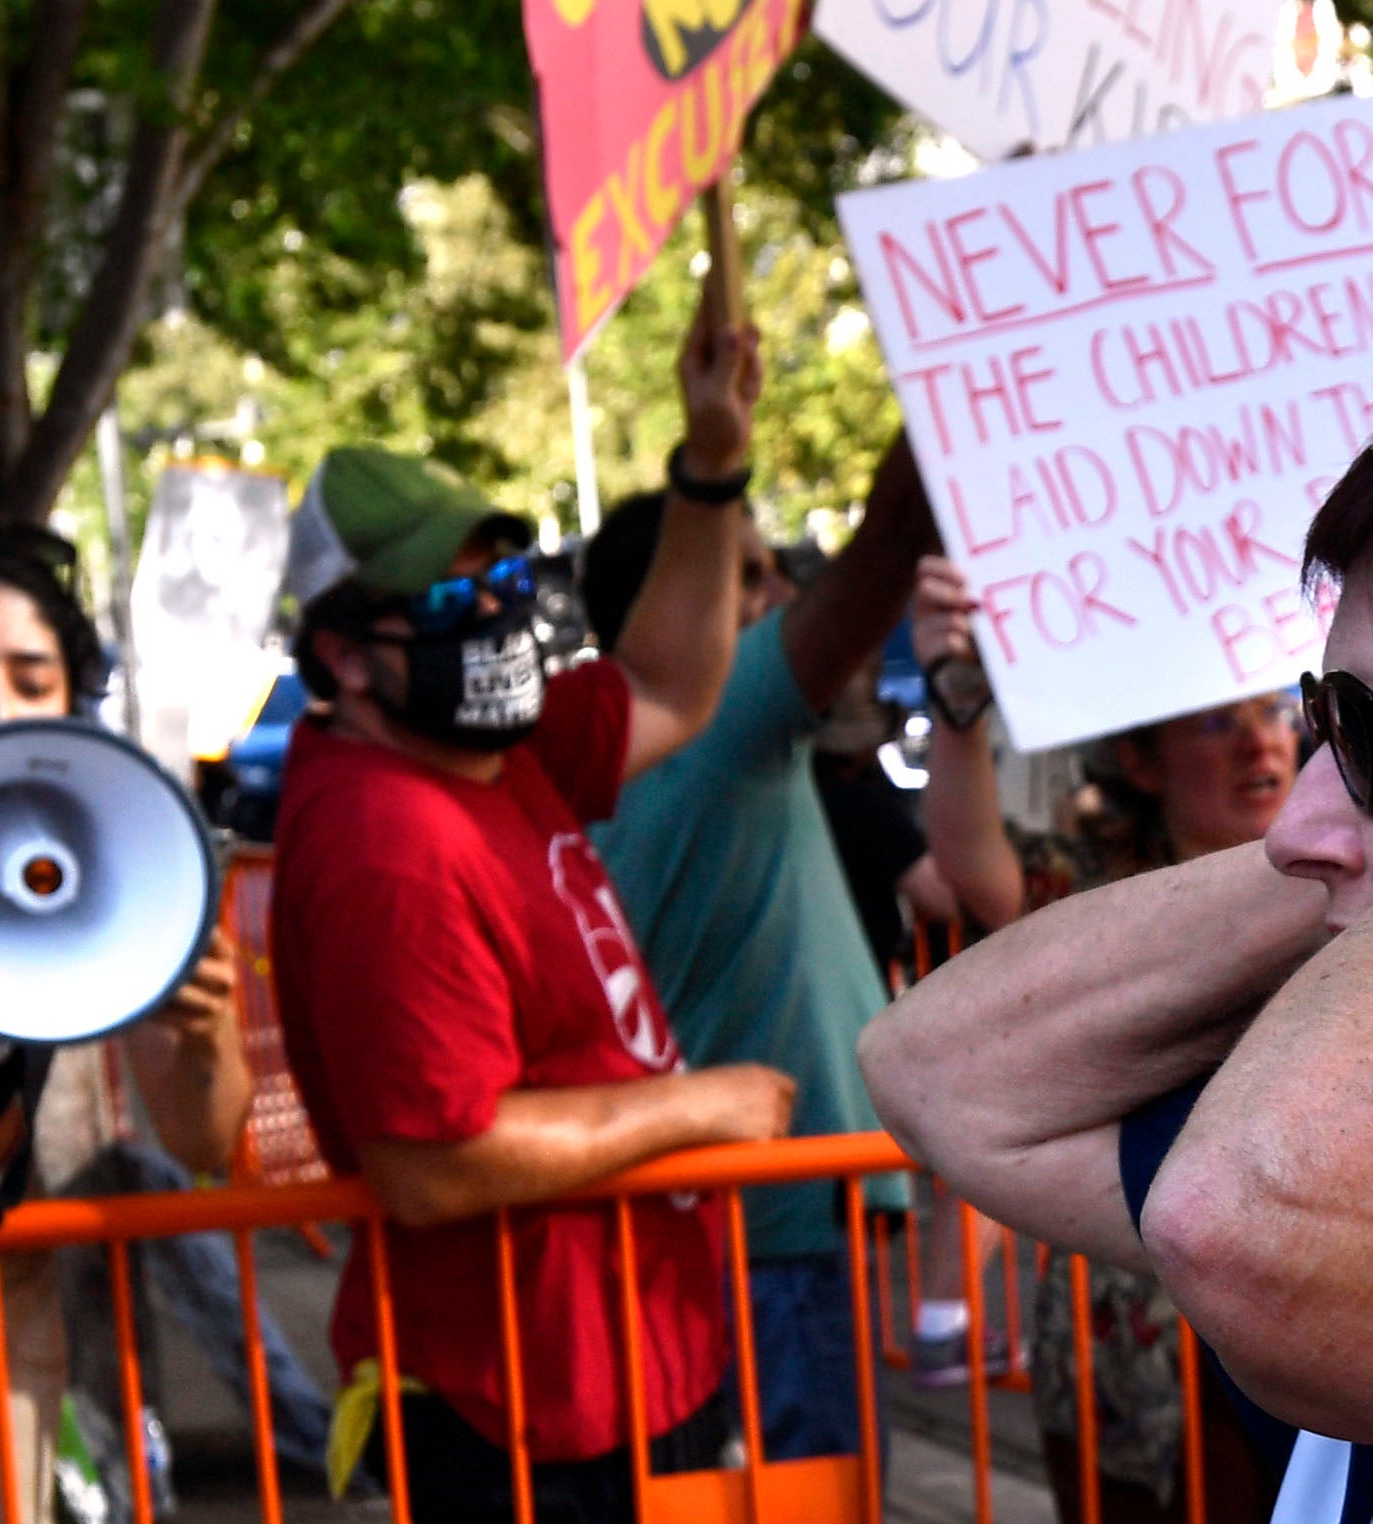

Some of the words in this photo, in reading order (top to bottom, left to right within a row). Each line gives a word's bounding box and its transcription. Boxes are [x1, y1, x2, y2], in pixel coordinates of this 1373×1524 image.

[877, 163, 1215, 343] NEVER
[902, 345, 1063, 456] THE
[946, 443, 1118, 557] LAID
[1124, 400, 1307, 520] DOWN
[979, 551, 1138, 666] FOR
[1126, 497, 1301, 620] YOUR
